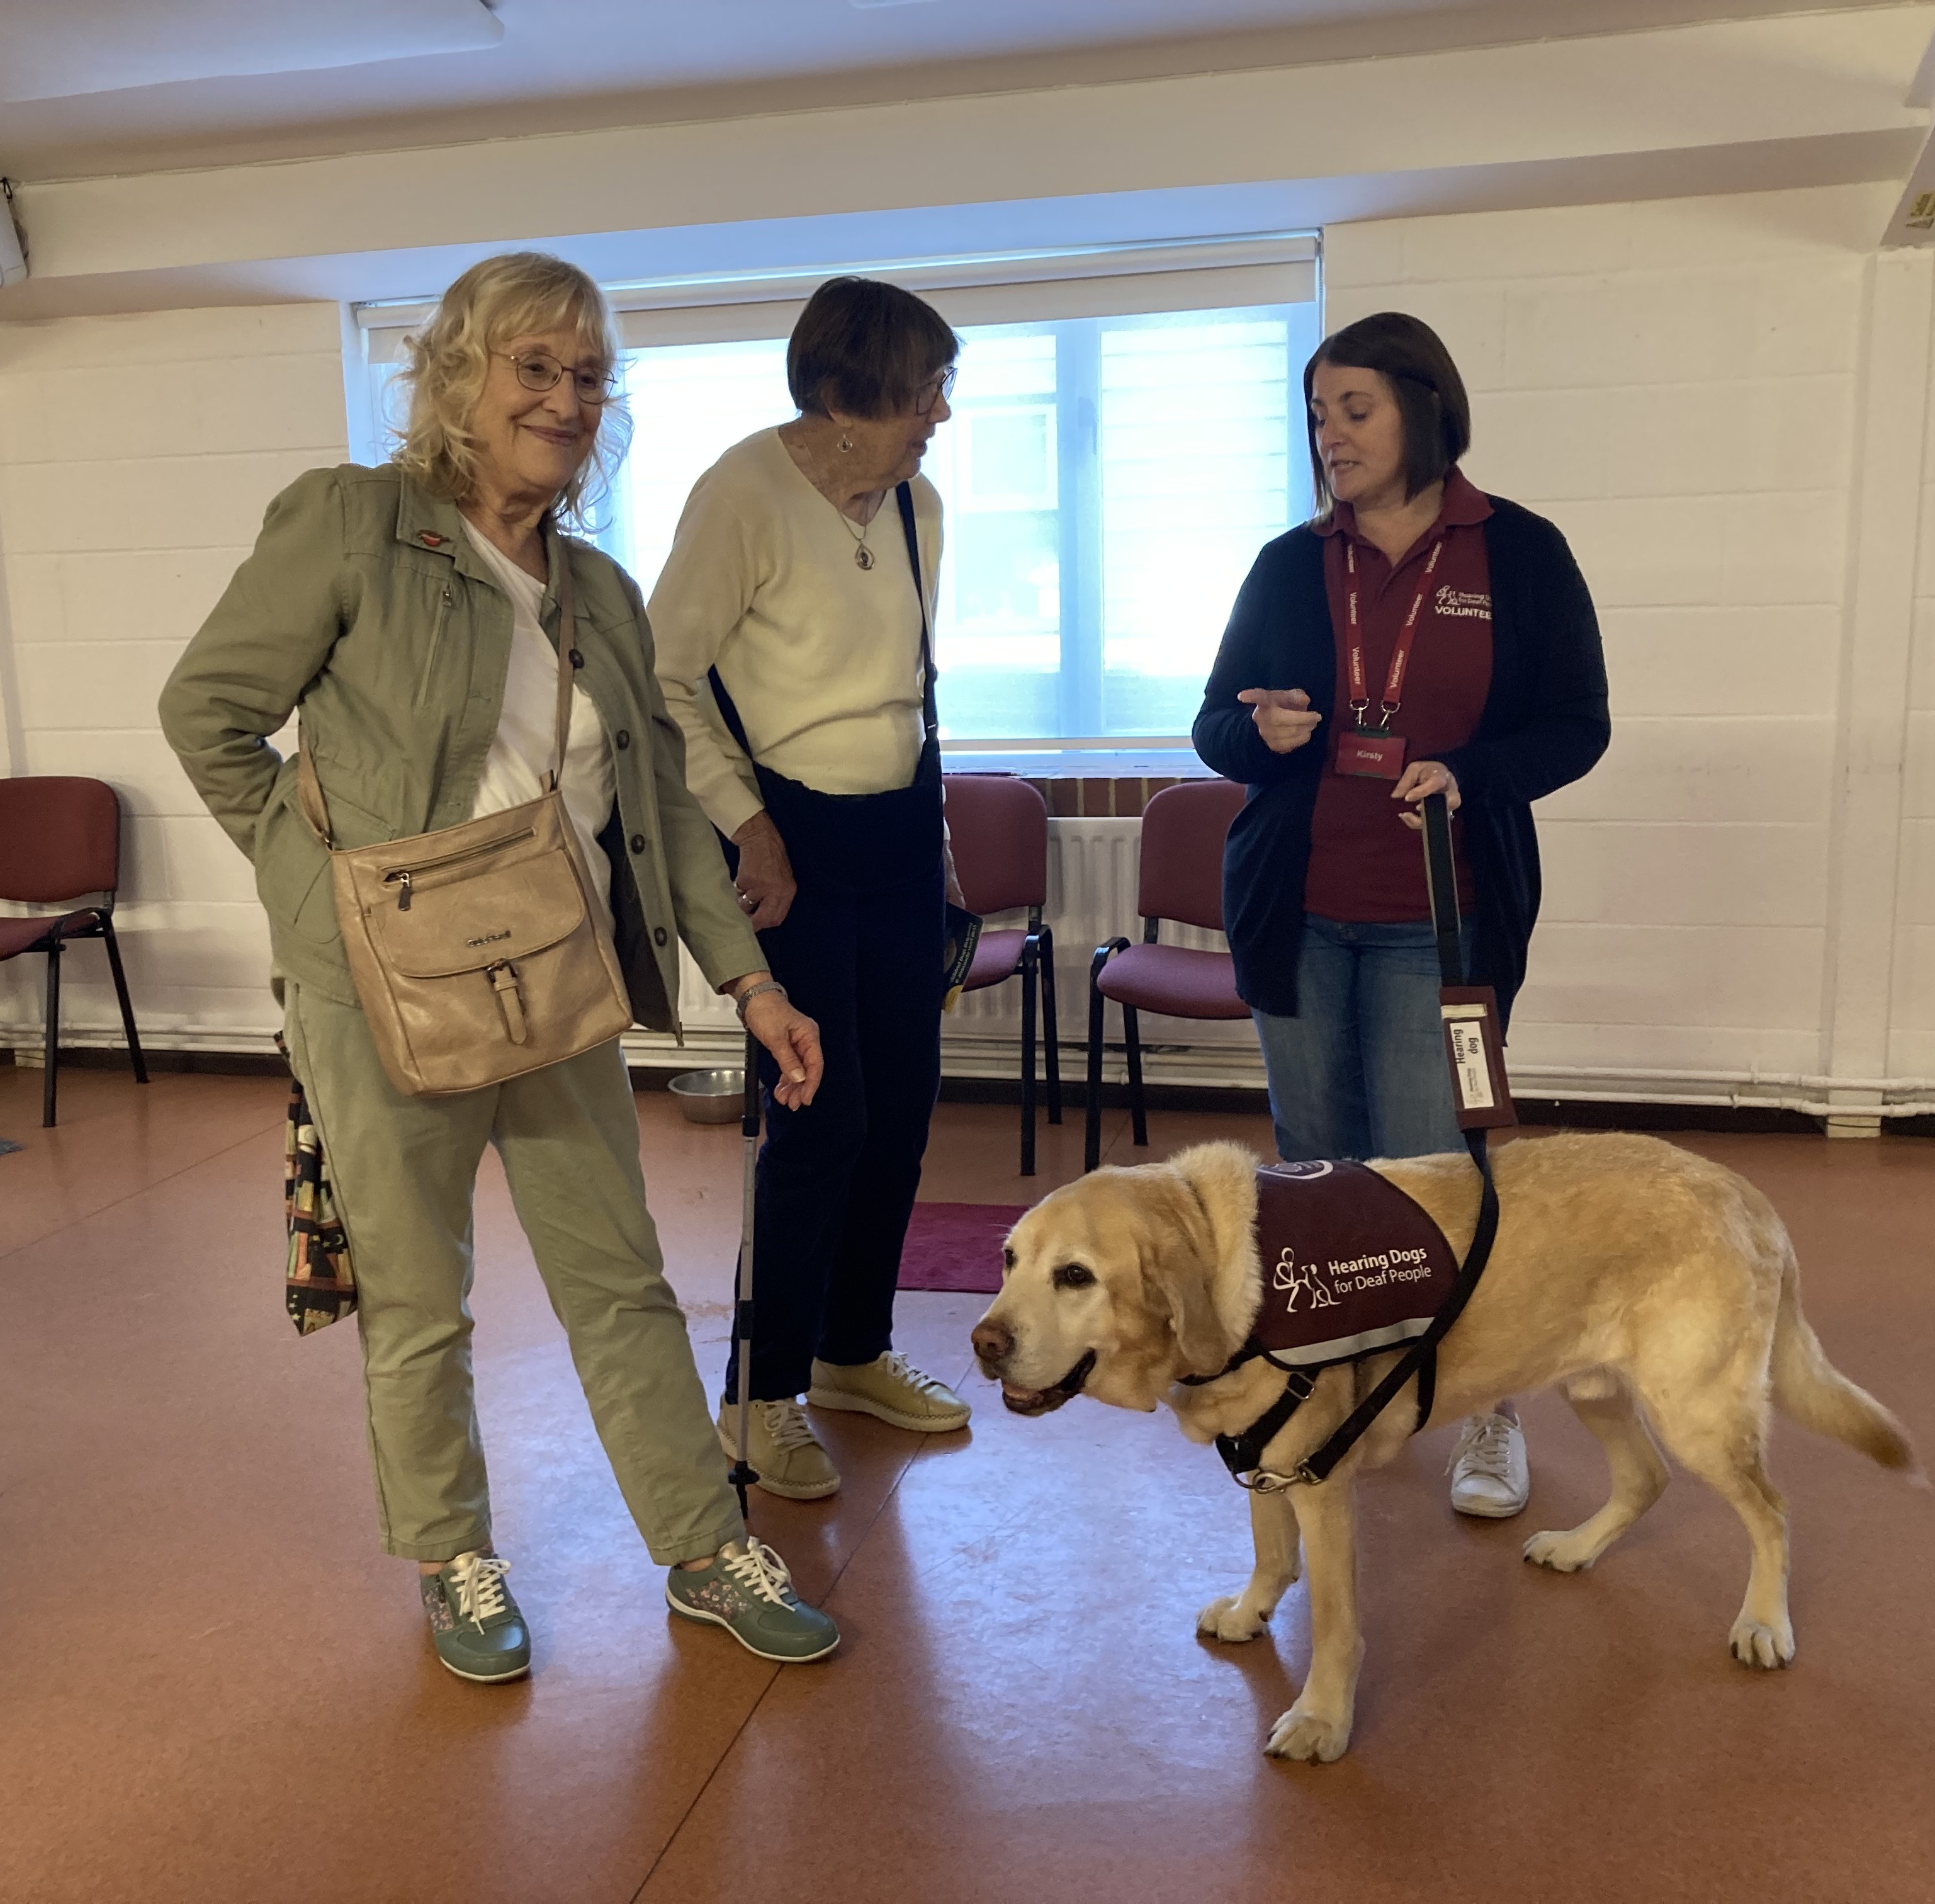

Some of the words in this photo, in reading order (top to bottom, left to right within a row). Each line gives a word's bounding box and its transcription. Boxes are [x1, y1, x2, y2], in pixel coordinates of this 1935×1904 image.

[1424, 541, 1443, 574] Volunteer
[1350, 592, 1358, 625] Volunteer
[1405, 593, 1423, 626] Volunteer
[1435, 606, 1493, 620] VOLUNTEE
[1352, 647, 1362, 685] Volunteer
[1389, 649, 1405, 688] Volunteer
[1357, 749, 1383, 762] Kirsty
[1454, 1029, 1465, 1064] Hearing
[1467, 1038, 1479, 1054] dog
[1328, 1254, 1389, 1276] Hearing
[1389, 1248, 1428, 1264] Dogs
[1334, 1279, 1353, 1294] for
[1355, 1270, 1387, 1290] Deaf
[1389, 1264, 1432, 1283] People
